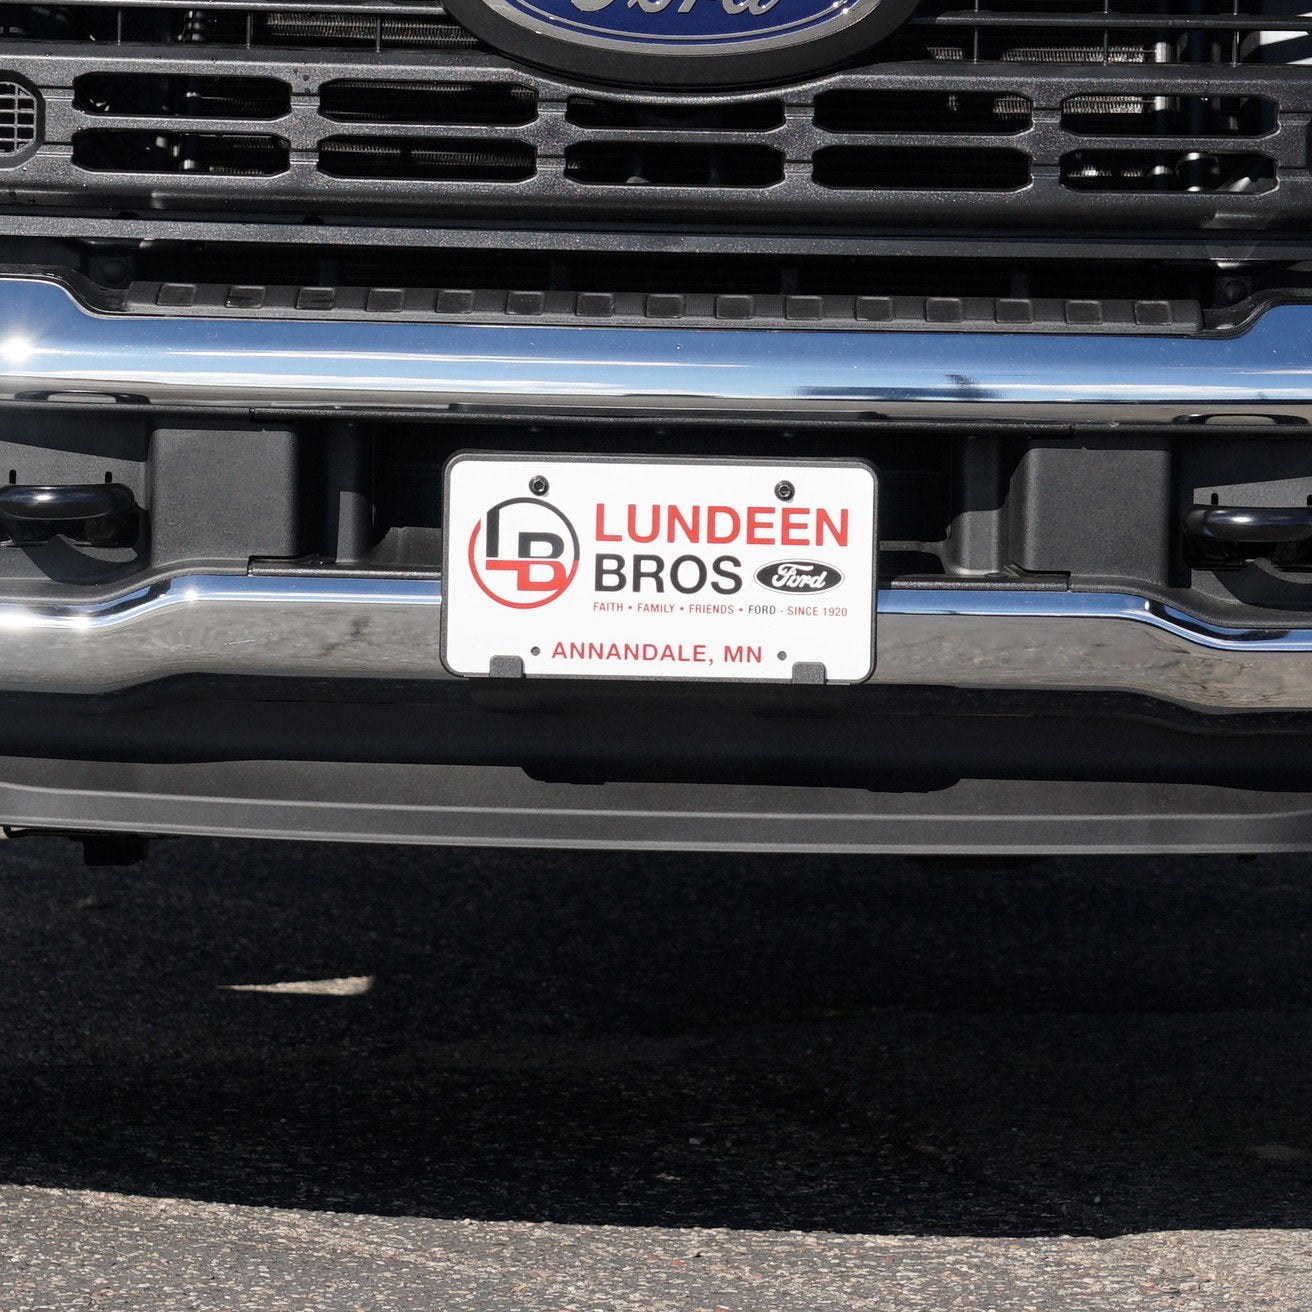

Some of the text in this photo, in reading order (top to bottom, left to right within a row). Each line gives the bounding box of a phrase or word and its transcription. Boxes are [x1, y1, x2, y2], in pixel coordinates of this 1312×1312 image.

[595, 503, 849, 547] LUNDEEN
[595, 553, 743, 595] BROS
[771, 563, 828, 588] Ford
[593, 602, 848, 617] FAITH FAMILY FRIENDS FORD SINCE 1920
[551, 642, 763, 665] ANNANDALE, MN
